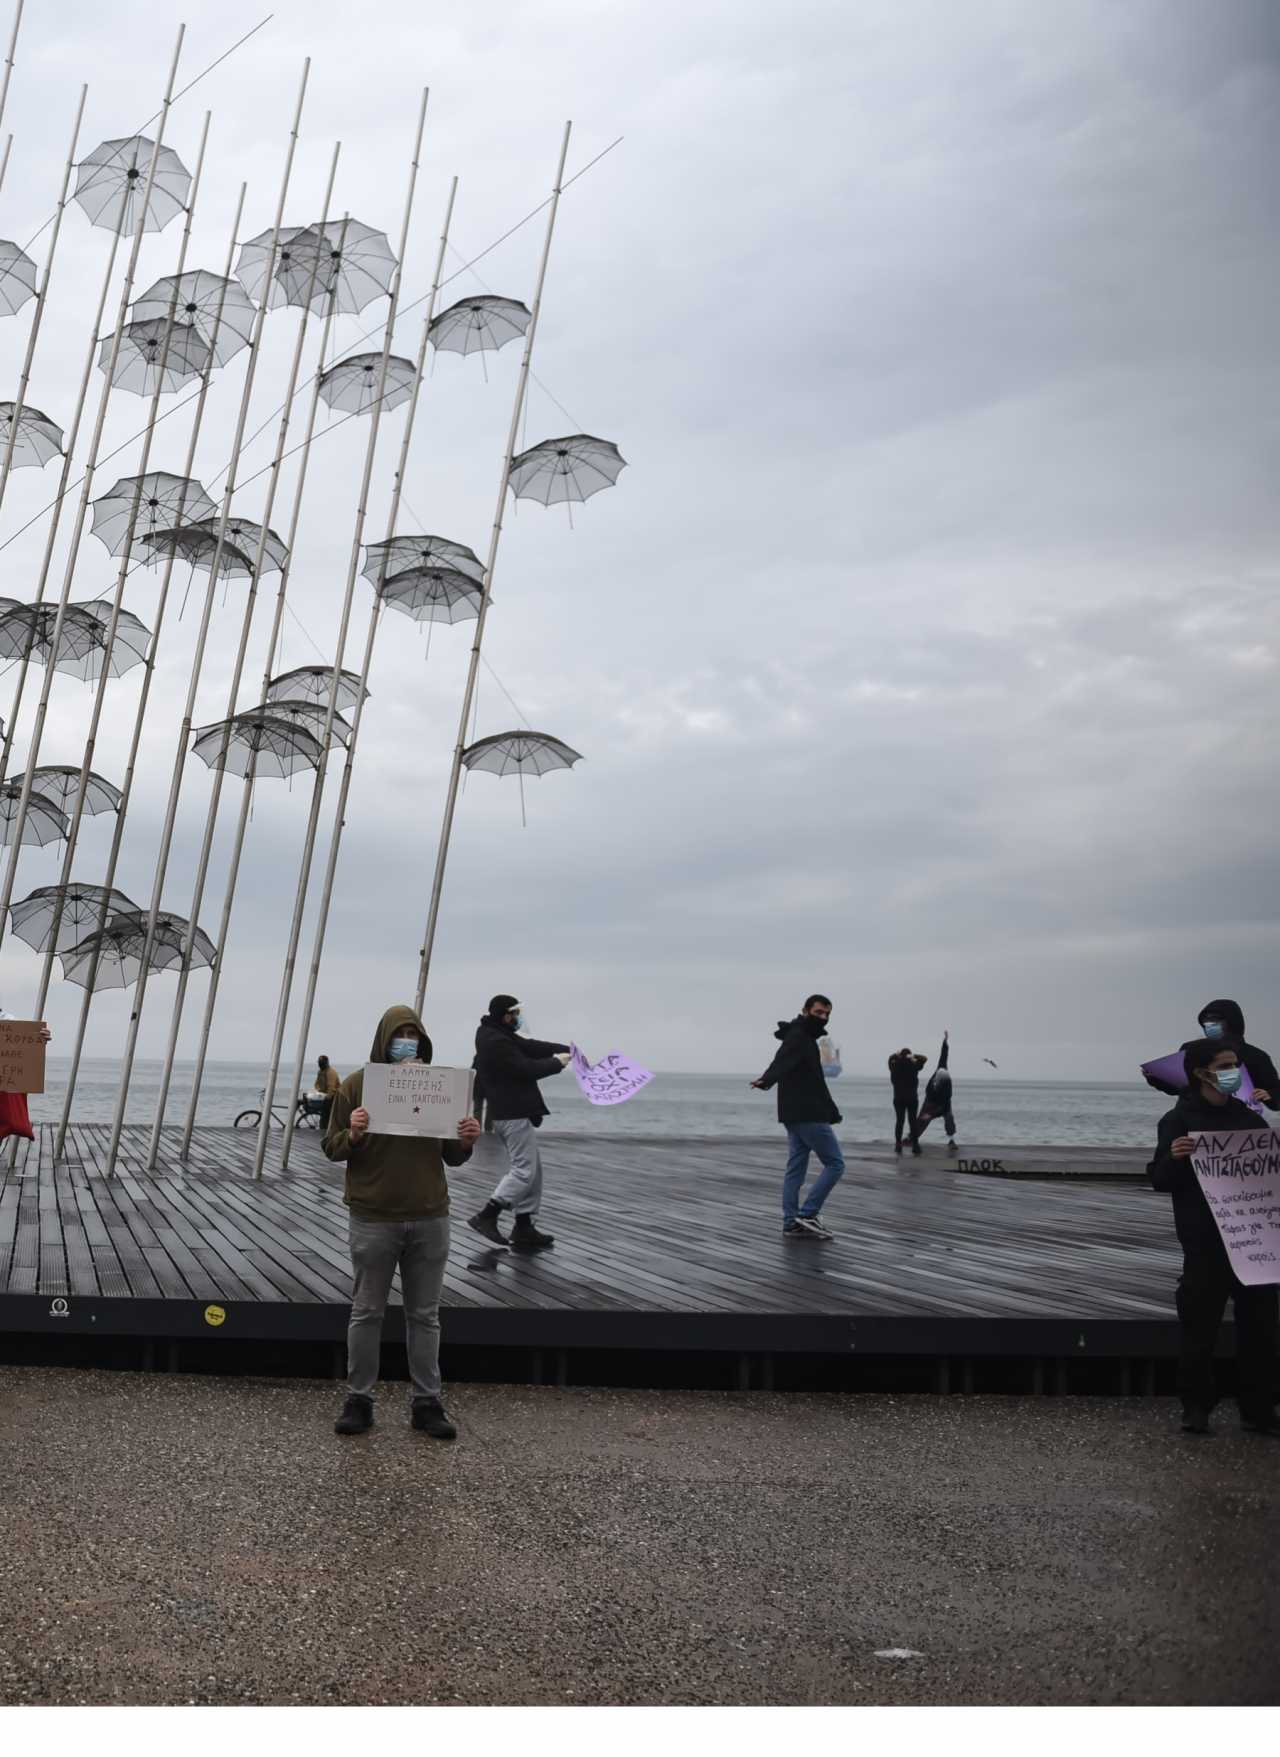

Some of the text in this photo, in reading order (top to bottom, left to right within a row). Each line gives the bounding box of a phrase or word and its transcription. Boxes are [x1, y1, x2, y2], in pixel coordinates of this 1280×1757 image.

[1194, 1133, 1235, 1154] ΑΝ
[958, 1159, 1008, 1172] ΠΑΟΚ
[1194, 1152, 1280, 1181] ΑΝΤΙΣΤΑΘΟΥΜ
